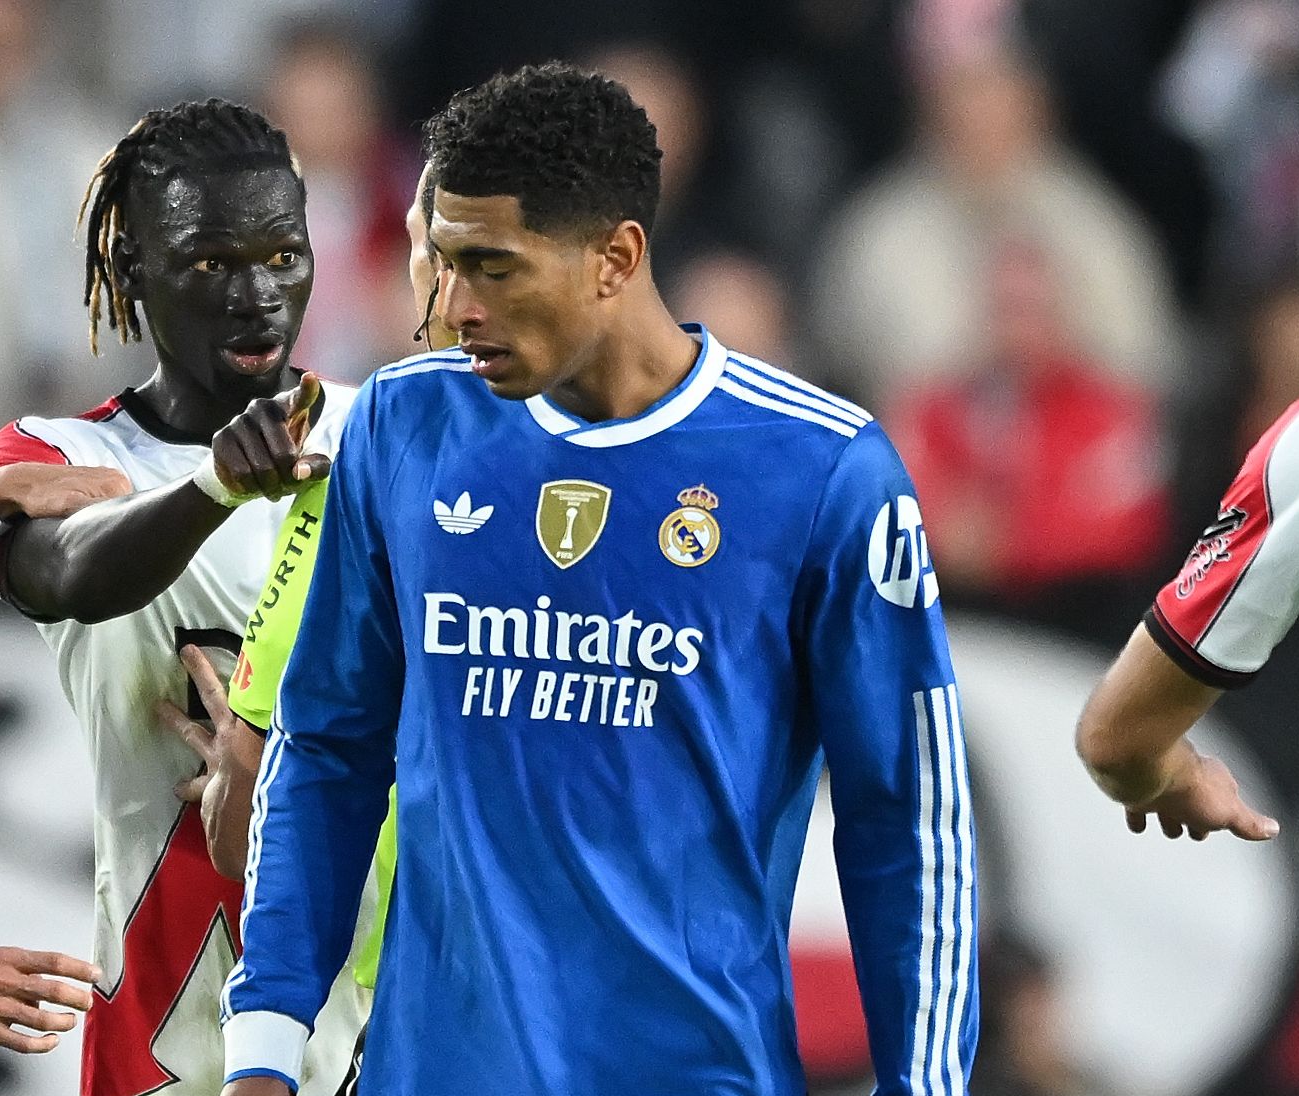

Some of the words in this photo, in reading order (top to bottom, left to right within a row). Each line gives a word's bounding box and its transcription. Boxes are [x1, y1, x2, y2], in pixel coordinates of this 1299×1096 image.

[246, 510, 319, 643] WÜRTH
[423, 592, 703, 676] Emirates
[461, 667, 523, 717] FLY
[530, 670, 658, 727] BETTER
